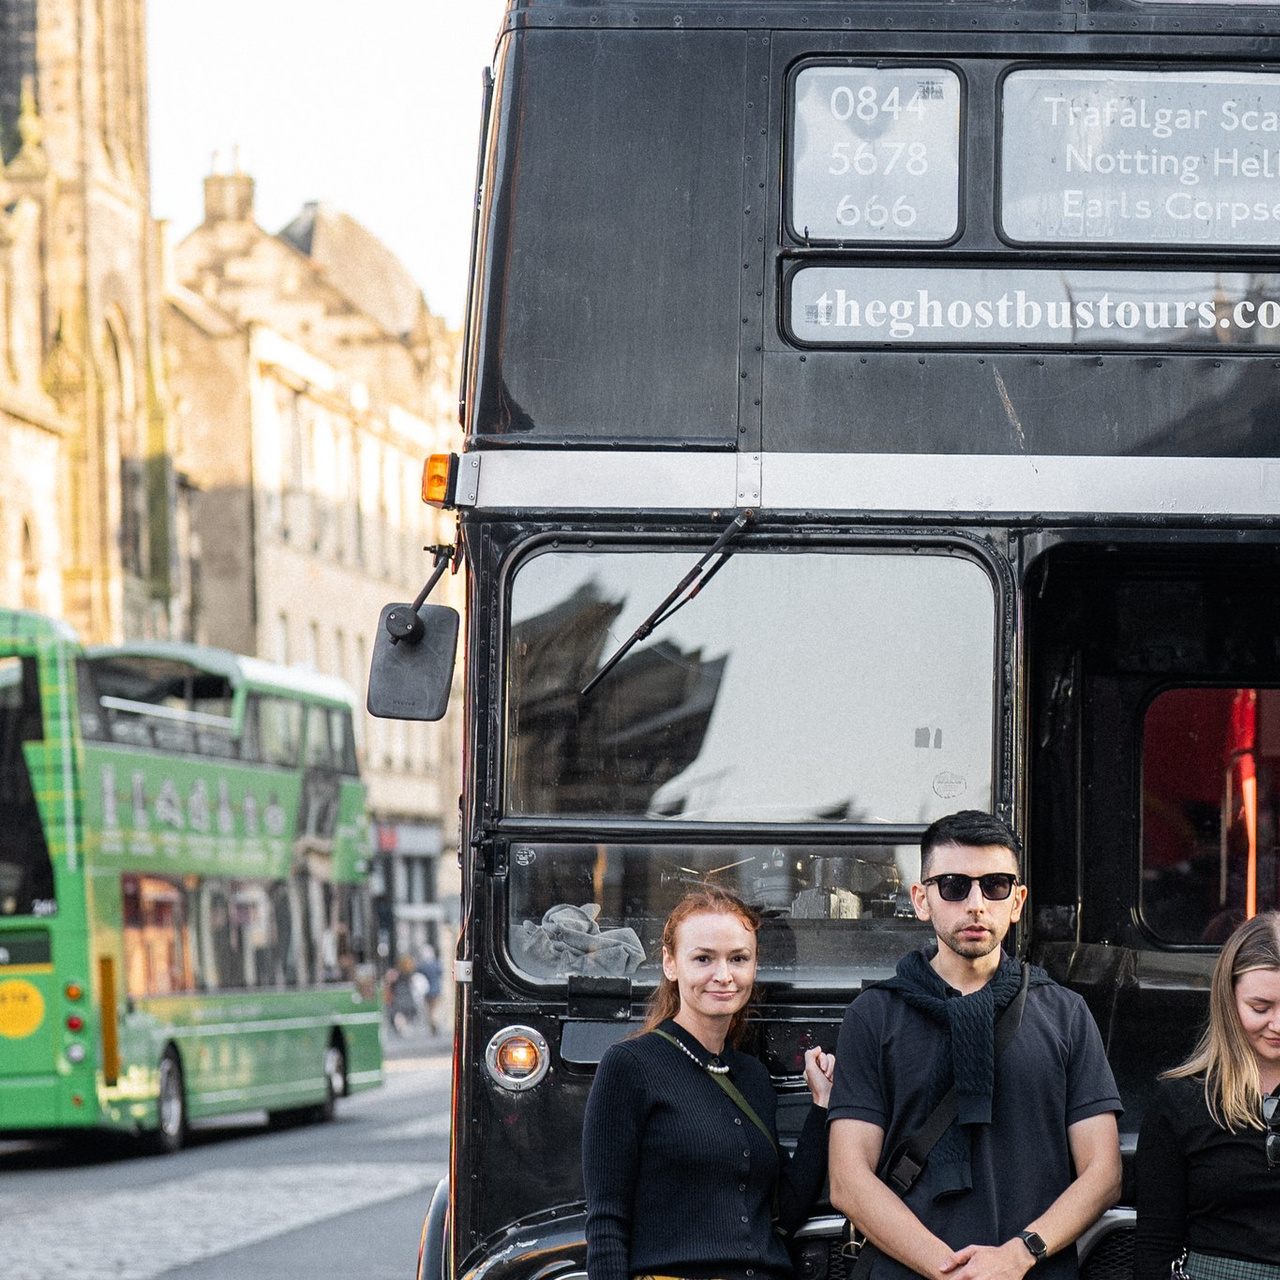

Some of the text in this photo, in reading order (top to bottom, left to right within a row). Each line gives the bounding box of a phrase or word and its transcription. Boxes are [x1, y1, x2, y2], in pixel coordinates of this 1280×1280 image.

[830, 85, 926, 121] 0844
[1044, 96, 1208, 139] Trafalgar
[828, 141, 929, 176] 5678
[1065, 143, 1201, 186] Notting
[835, 194, 917, 227] 666
[1063, 189, 1152, 219] Earls
